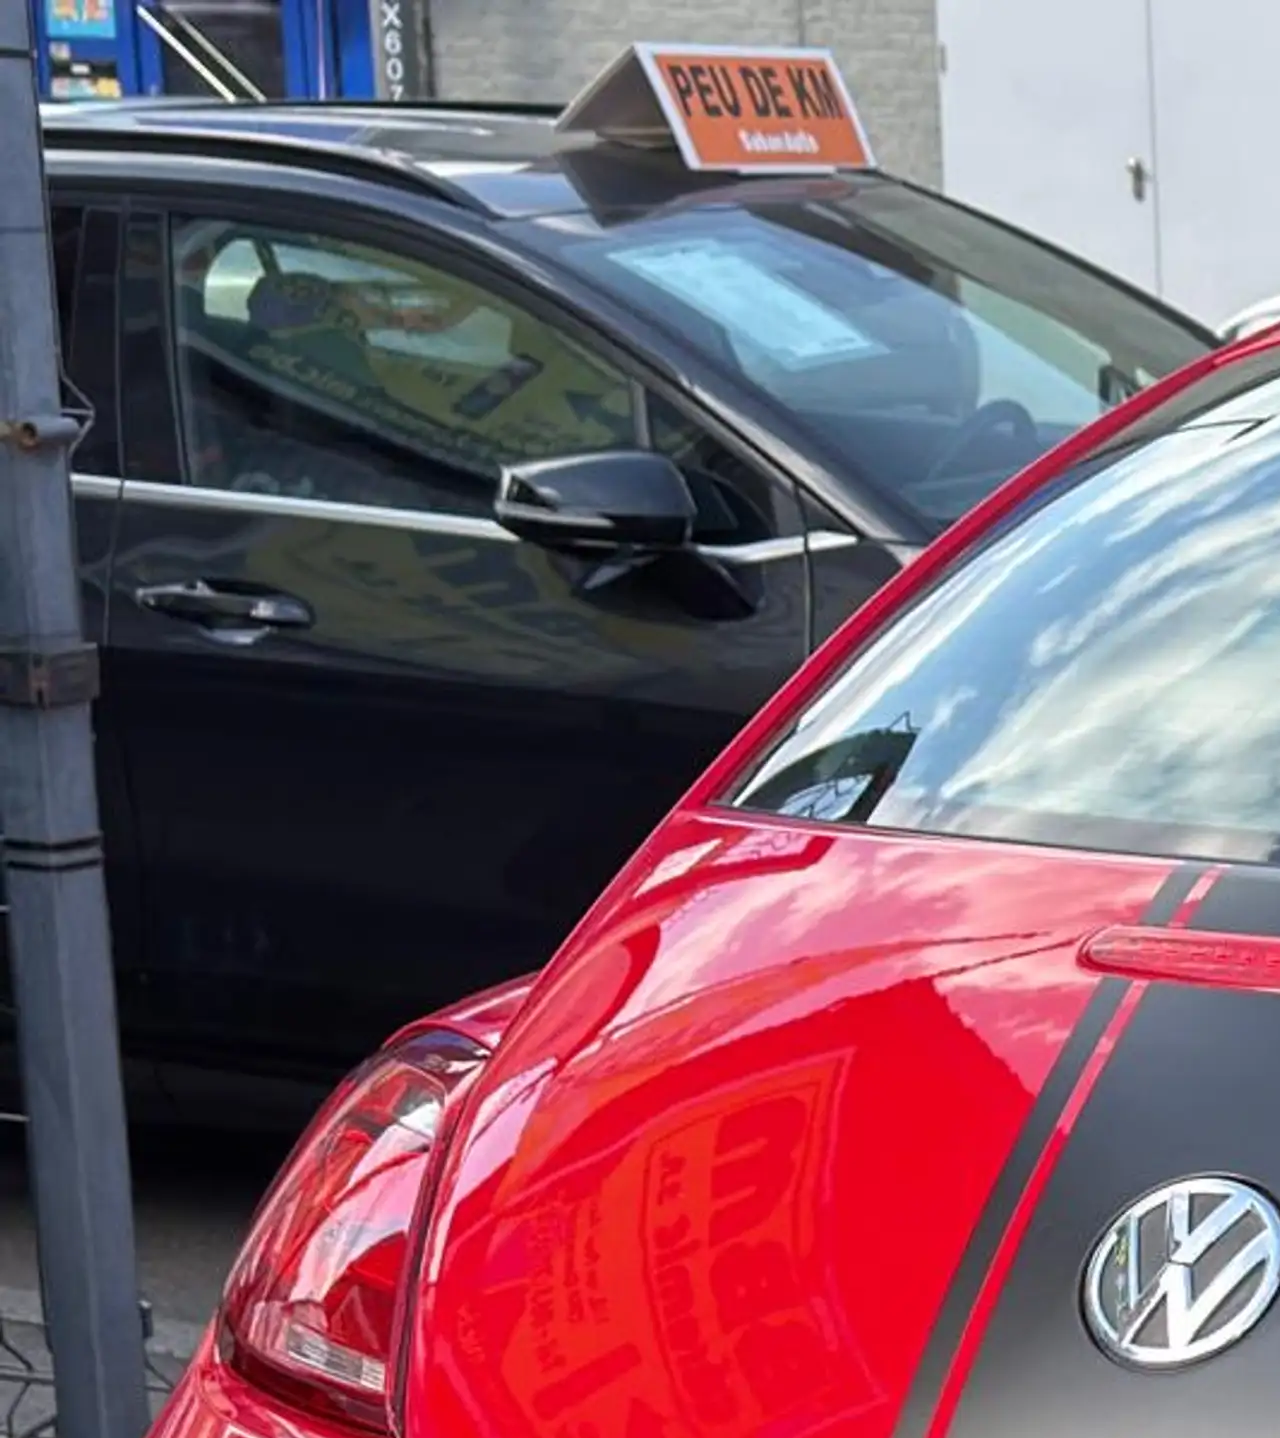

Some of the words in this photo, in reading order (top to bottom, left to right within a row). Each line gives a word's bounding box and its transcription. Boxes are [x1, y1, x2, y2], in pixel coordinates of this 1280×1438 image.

[668, 64, 742, 118] PEU
[738, 66, 793, 118] DE
[786, 65, 844, 119] KM
